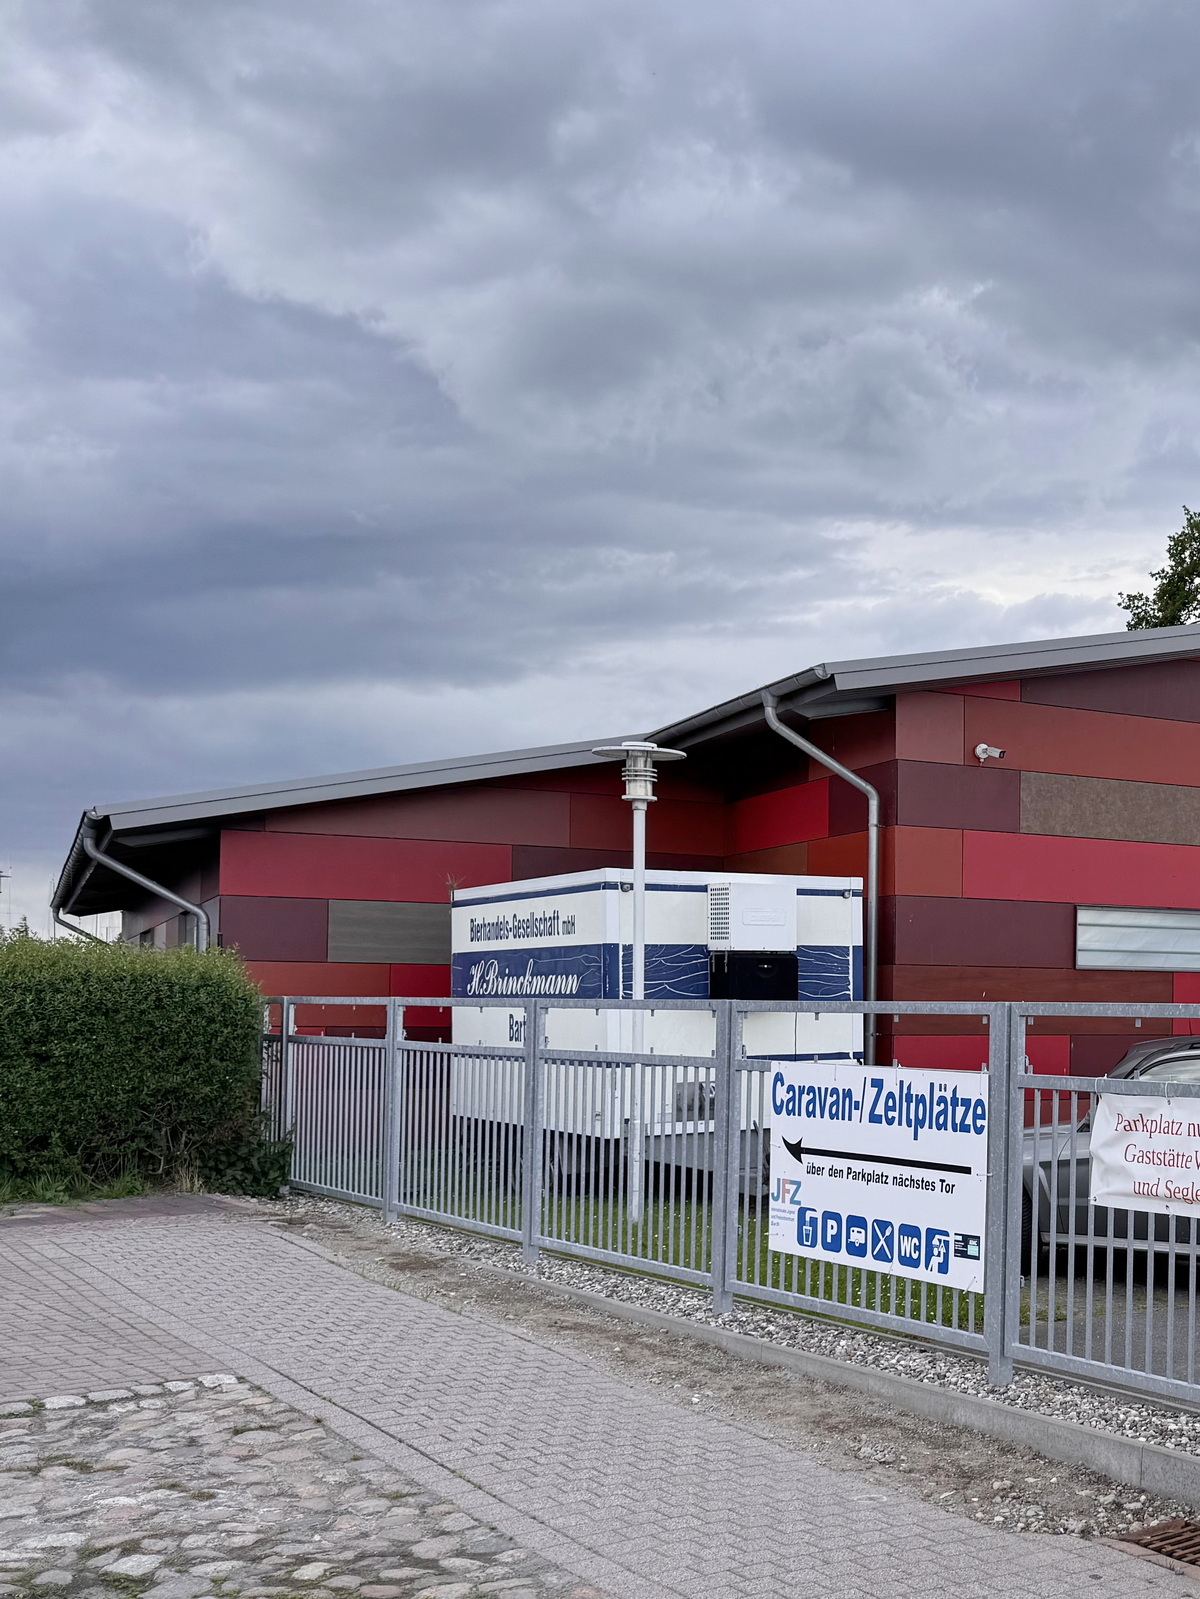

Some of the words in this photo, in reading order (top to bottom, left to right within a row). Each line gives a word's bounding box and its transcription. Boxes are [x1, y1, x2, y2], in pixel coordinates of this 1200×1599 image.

[470, 910, 560, 942] Bierhandels-Gesellschaft
[562, 915, 576, 935] mbH
[509, 1013, 527, 1042] Bart
[1114, 1113, 1183, 1139] Parkplatz
[1124, 1143, 1193, 1170] Gaststätte
[771, 1177, 802, 1206] JFZ
[806, 1162, 825, 1177] über
[828, 1165, 844, 1179] den
[846, 1166, 889, 1186] Parkplatz
[892, 1173, 936, 1192] nächstes
[939, 1179, 956, 1194] Tor
[1133, 1178, 1160, 1198] und
[826, 1218, 838, 1244] P
[900, 1234, 920, 1259] WC
